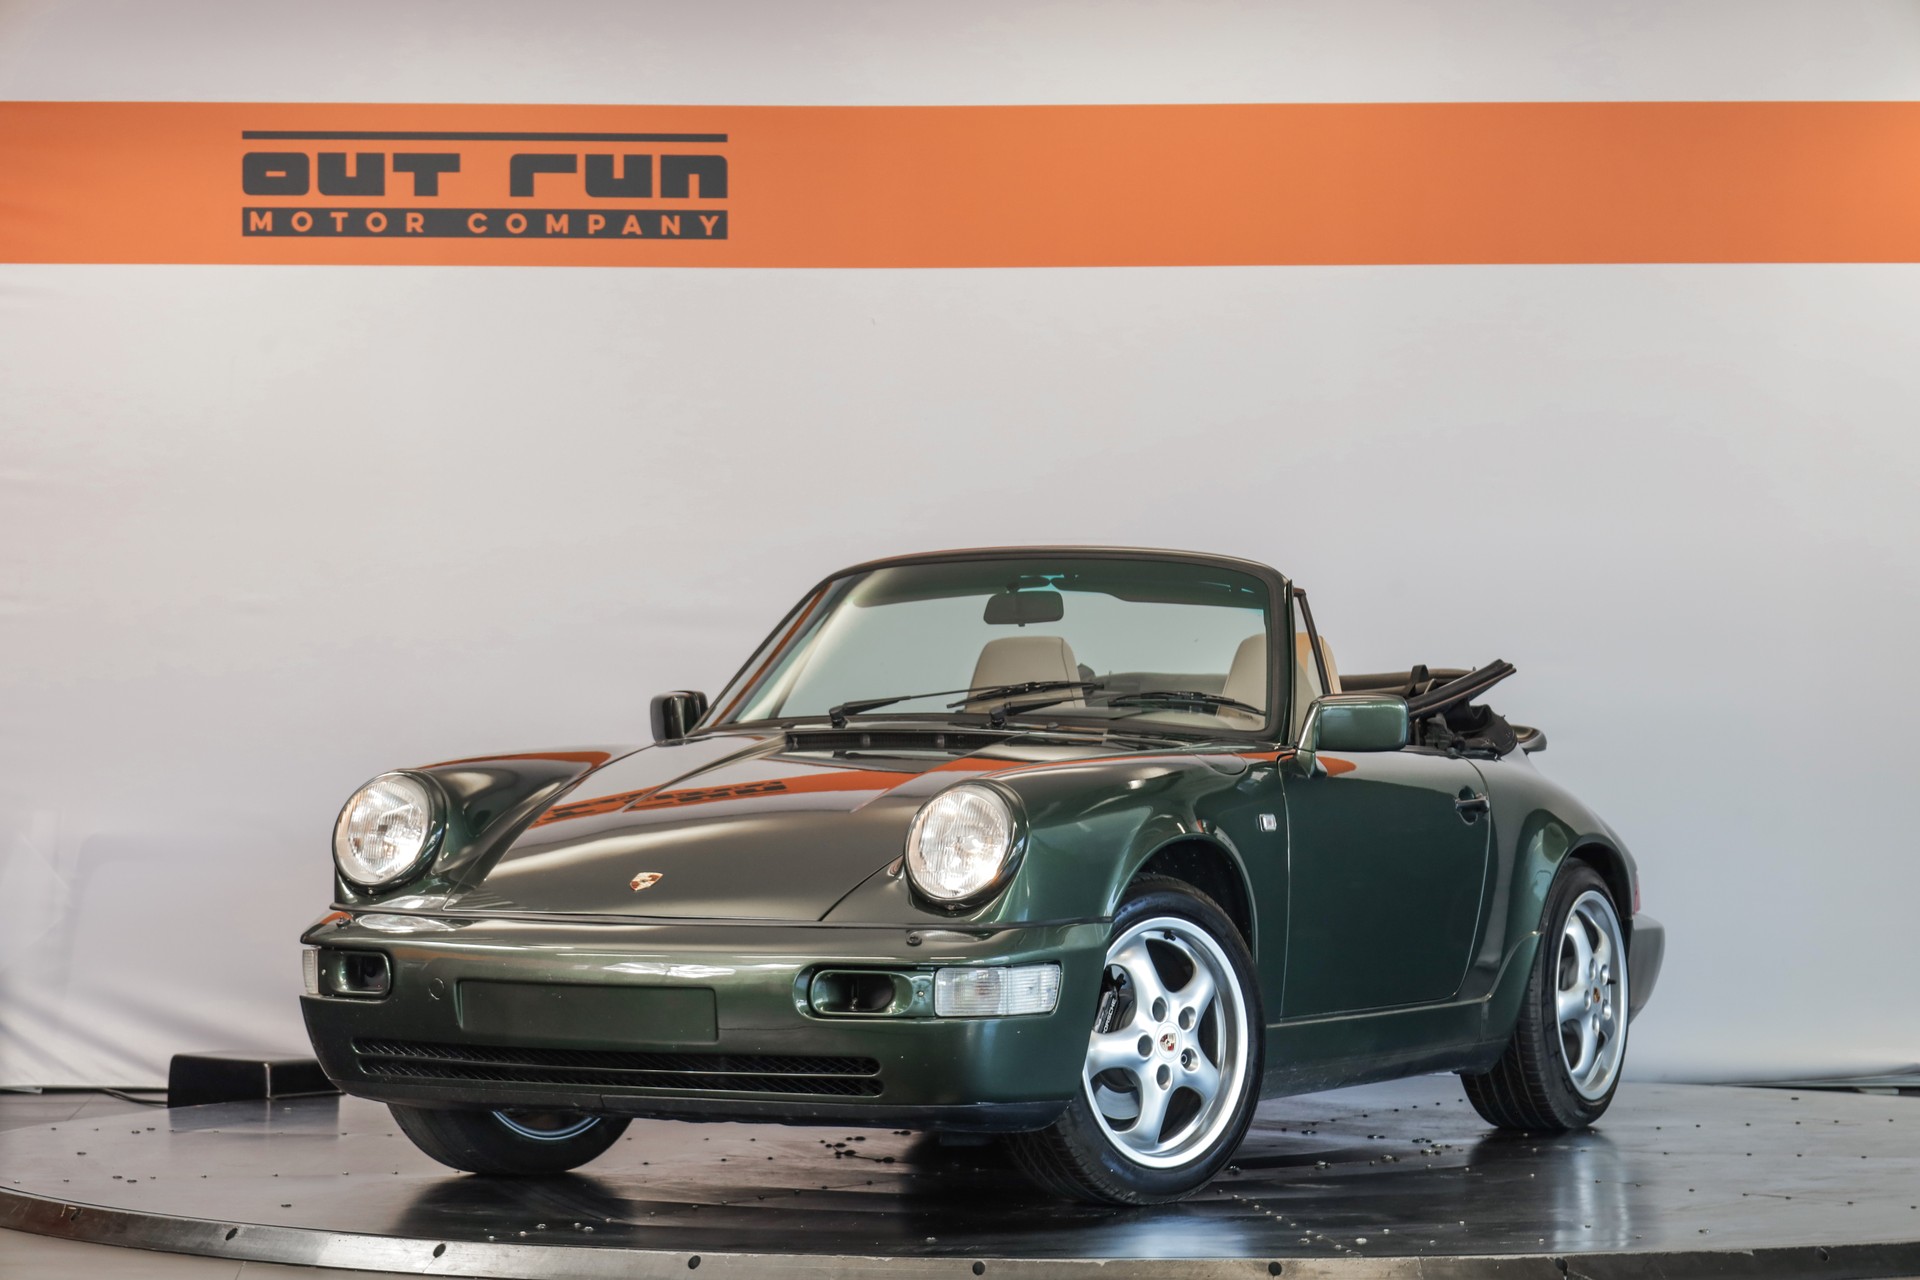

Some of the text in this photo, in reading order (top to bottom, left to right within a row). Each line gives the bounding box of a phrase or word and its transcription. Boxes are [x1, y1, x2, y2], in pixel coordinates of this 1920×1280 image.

[242, 151, 461, 197] OUT
[249, 211, 719, 236] MOTOR COMPANY
